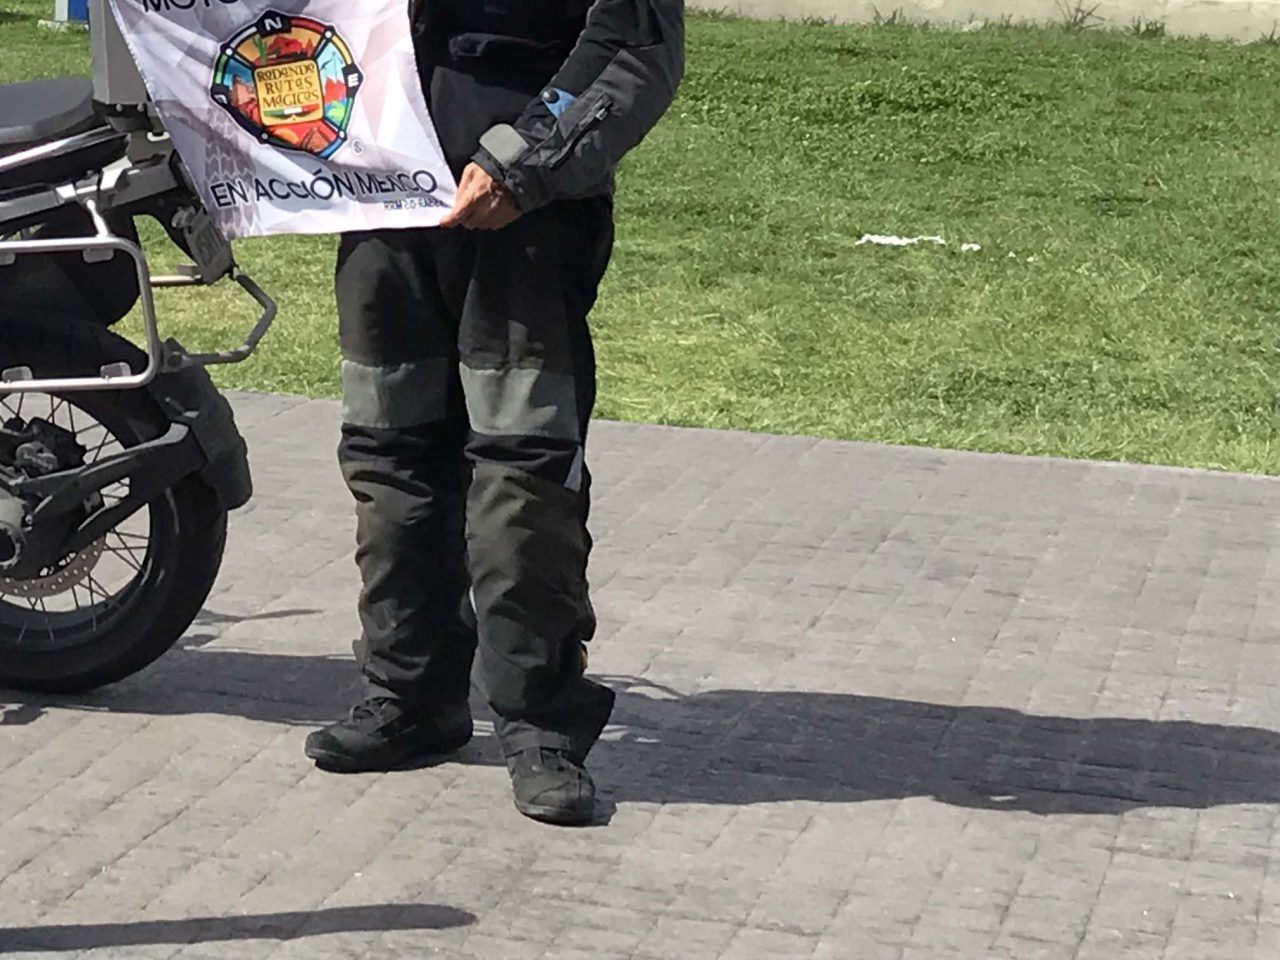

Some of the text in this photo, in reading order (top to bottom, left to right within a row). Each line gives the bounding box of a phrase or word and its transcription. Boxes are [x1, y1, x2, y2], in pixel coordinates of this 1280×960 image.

[265, 16, 282, 31] N
[210, 180, 250, 208] EN
[254, 168, 356, 202] ACCIÓN
